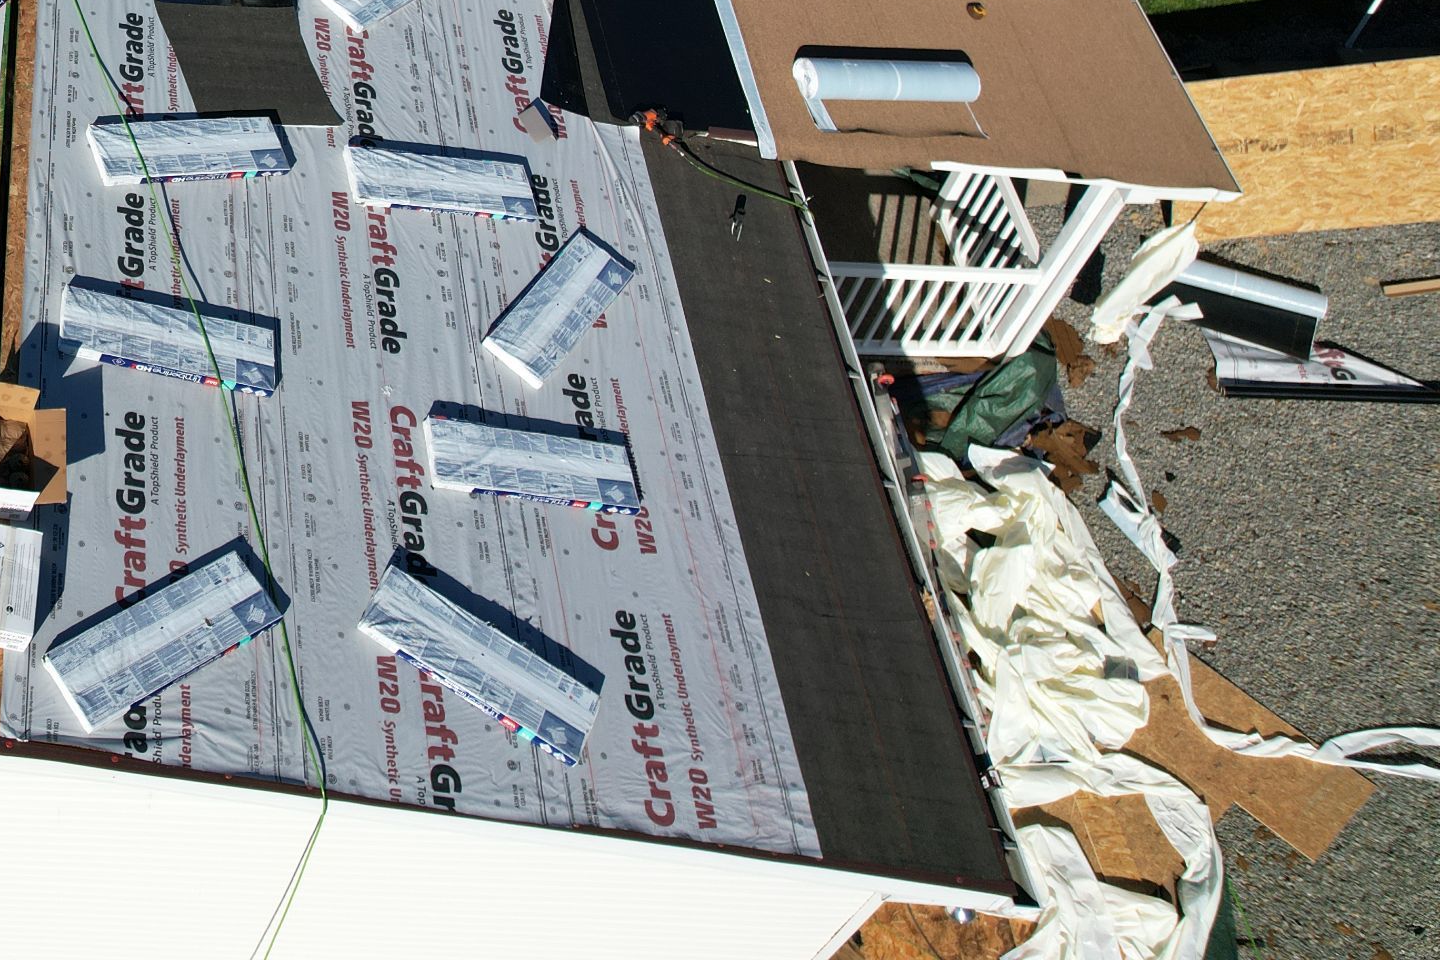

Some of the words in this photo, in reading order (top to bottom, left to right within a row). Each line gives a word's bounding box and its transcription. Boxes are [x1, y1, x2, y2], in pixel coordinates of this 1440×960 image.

[148, 42, 156, 71] TopShield
[314, 18, 332, 52] W20
[168, 75, 180, 111] Synthetic
[171, 198, 181, 263] Underlayment
[331, 192, 351, 231] W20
[149, 227, 157, 262] TopShield
[335, 236, 350, 279] Synthetic
[341, 281, 355, 349] Underlayment
[363, 279, 373, 316] TopShield
[368, 319, 377, 349] Product
[590, 377, 602, 407] Product
[151, 416, 159, 450] Product
[351, 401, 374, 449] W20
[151, 454, 161, 497] TopShield
[174, 417, 188, 497] Underlayment
[358, 453, 371, 506] Synthetic
[175, 497, 190, 555] Synthetic
[640, 614, 654, 650] Product
[661, 613, 689, 698] Underlayment
[376, 655, 401, 714] W20
[646, 652, 664, 699] TopShield
[179, 684, 194, 768] nderlayment
[610, 609, 675, 827] CraftGrade
[679, 701, 704, 762] Synthetic
[383, 721, 403, 784] Synthetic
[688, 768, 717, 830] W20
